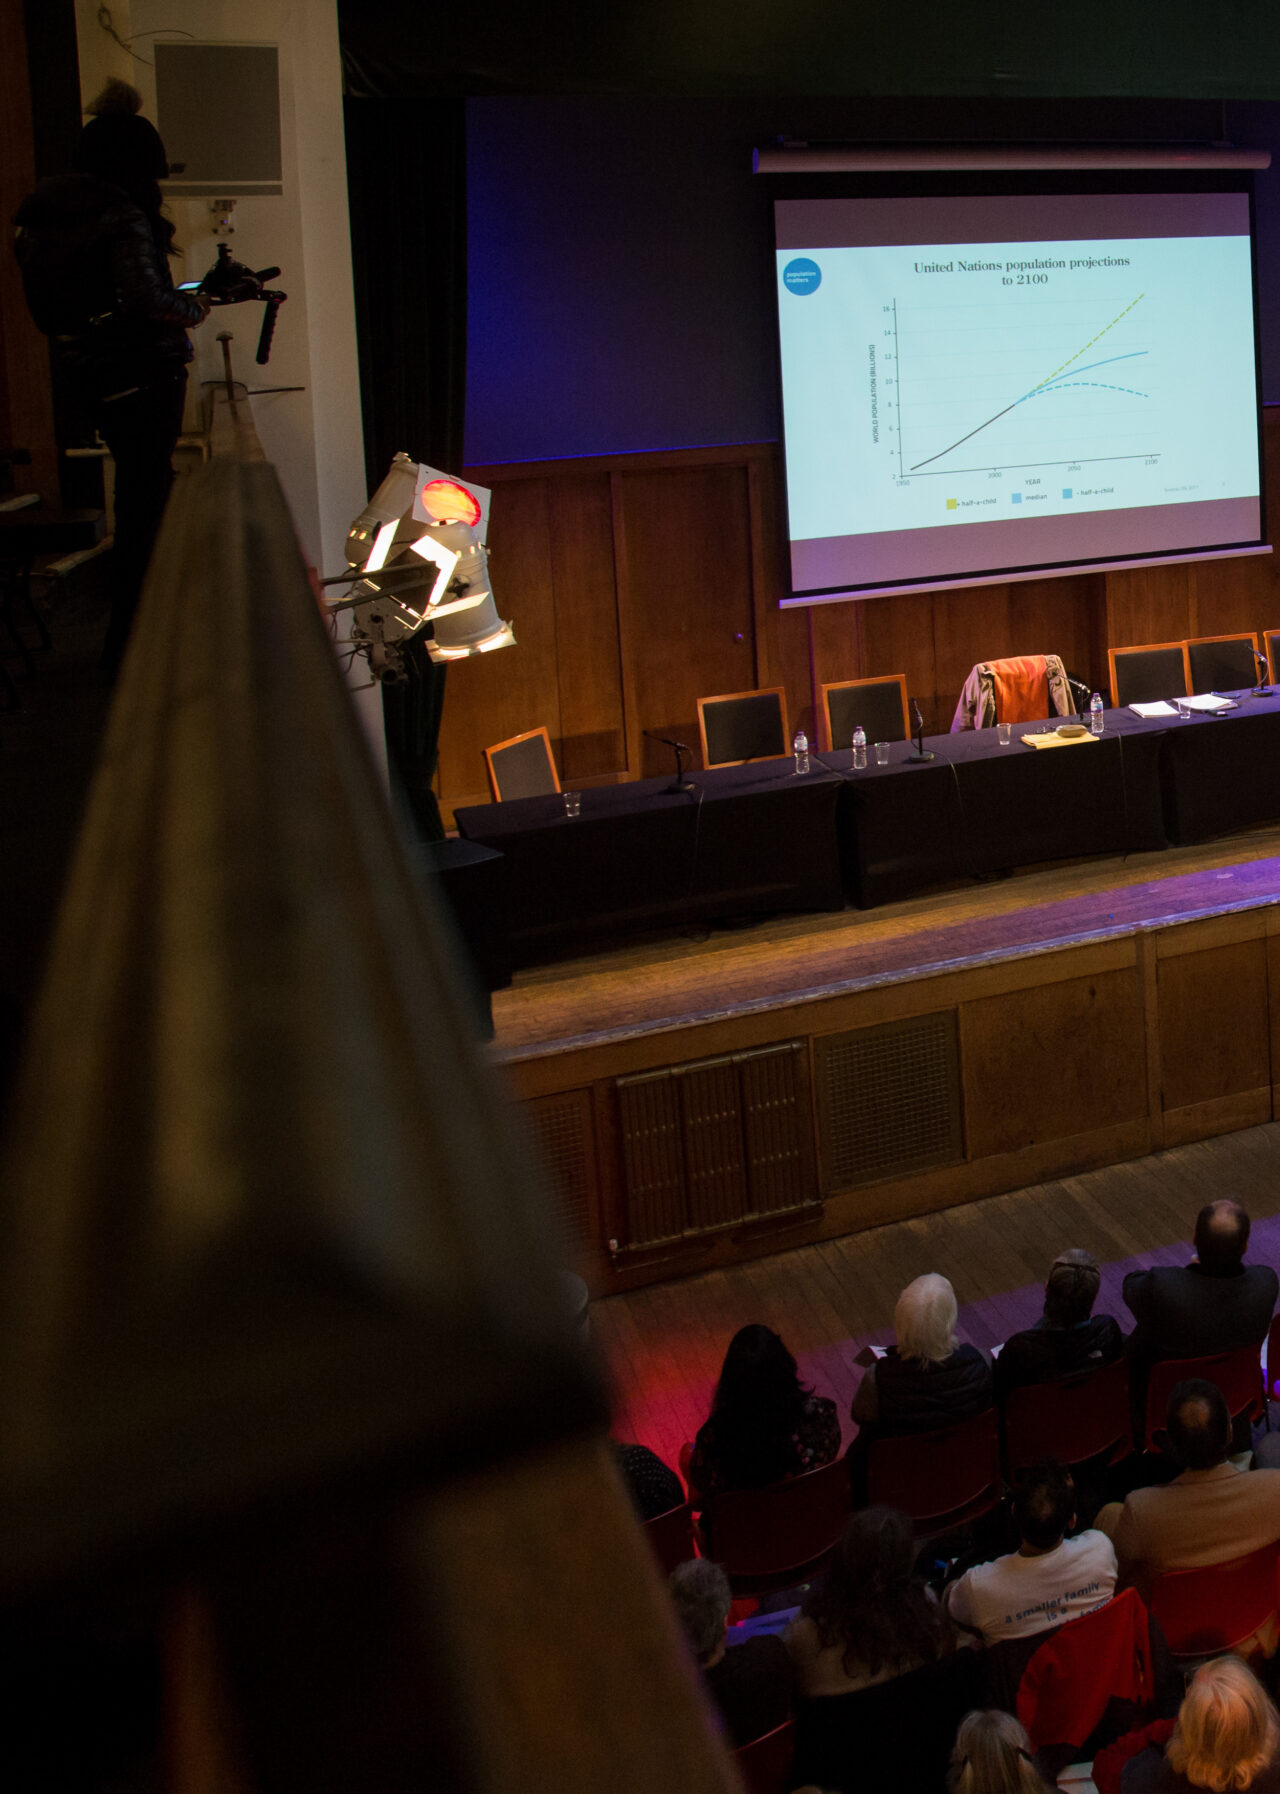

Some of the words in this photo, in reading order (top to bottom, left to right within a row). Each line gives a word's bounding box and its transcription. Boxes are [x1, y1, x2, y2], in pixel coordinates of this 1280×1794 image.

[914, 261, 953, 273] United
[957, 260, 1002, 272] Nations
[1006, 257, 1066, 272] population
[1069, 255, 1130, 271] projections
[1002, 275, 1013, 285] to
[1016, 274, 1048, 285] 2100
[870, 378, 878, 418] POPULATION
[1025, 478, 1041, 486] YEAR
[961, 497, 997, 507] half-a-child
[1025, 493, 1048, 501] median
[1015, 1597, 1062, 1621] smaller
[1064, 1582, 1100, 1602] family
